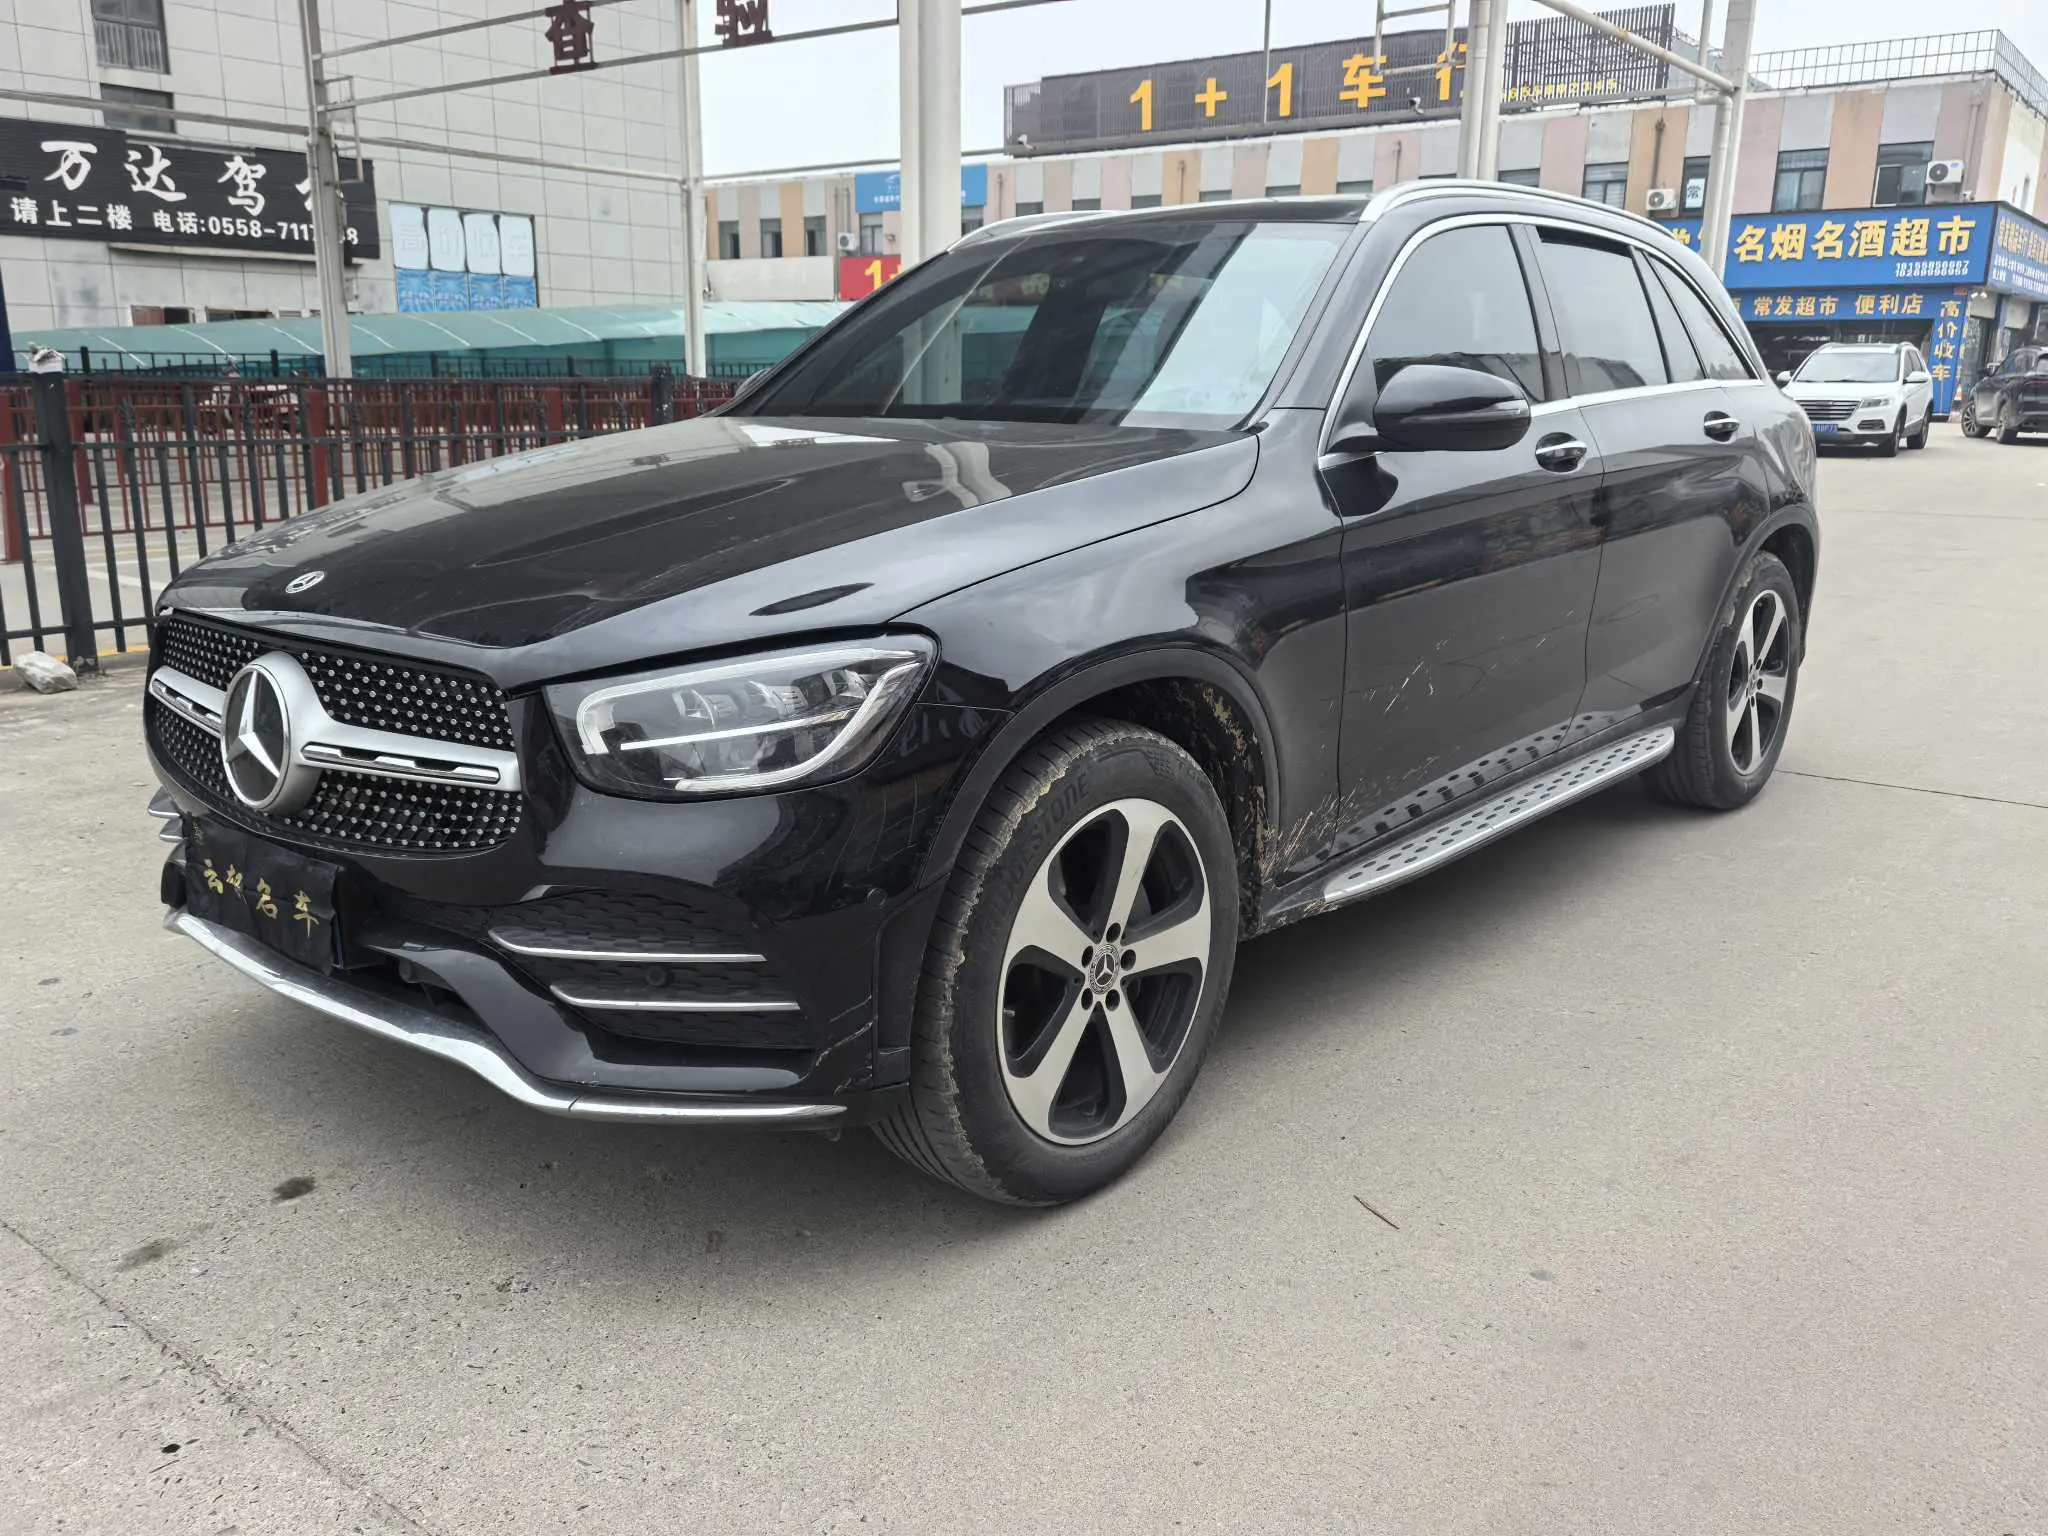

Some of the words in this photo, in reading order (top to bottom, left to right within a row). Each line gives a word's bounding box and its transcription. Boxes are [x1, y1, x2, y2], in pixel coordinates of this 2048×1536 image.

[41, 141, 344, 216] 万达驾
[10, 197, 133, 230] 请上二楼
[153, 210, 358, 246] 电话:0558-7118
[1733, 215, 1976, 262] 名烟名酒超市
[1753, 296, 1839, 316] 常发超市
[1855, 293, 1924, 315] 便利店
[1932, 300, 1961, 381] 高价收车
